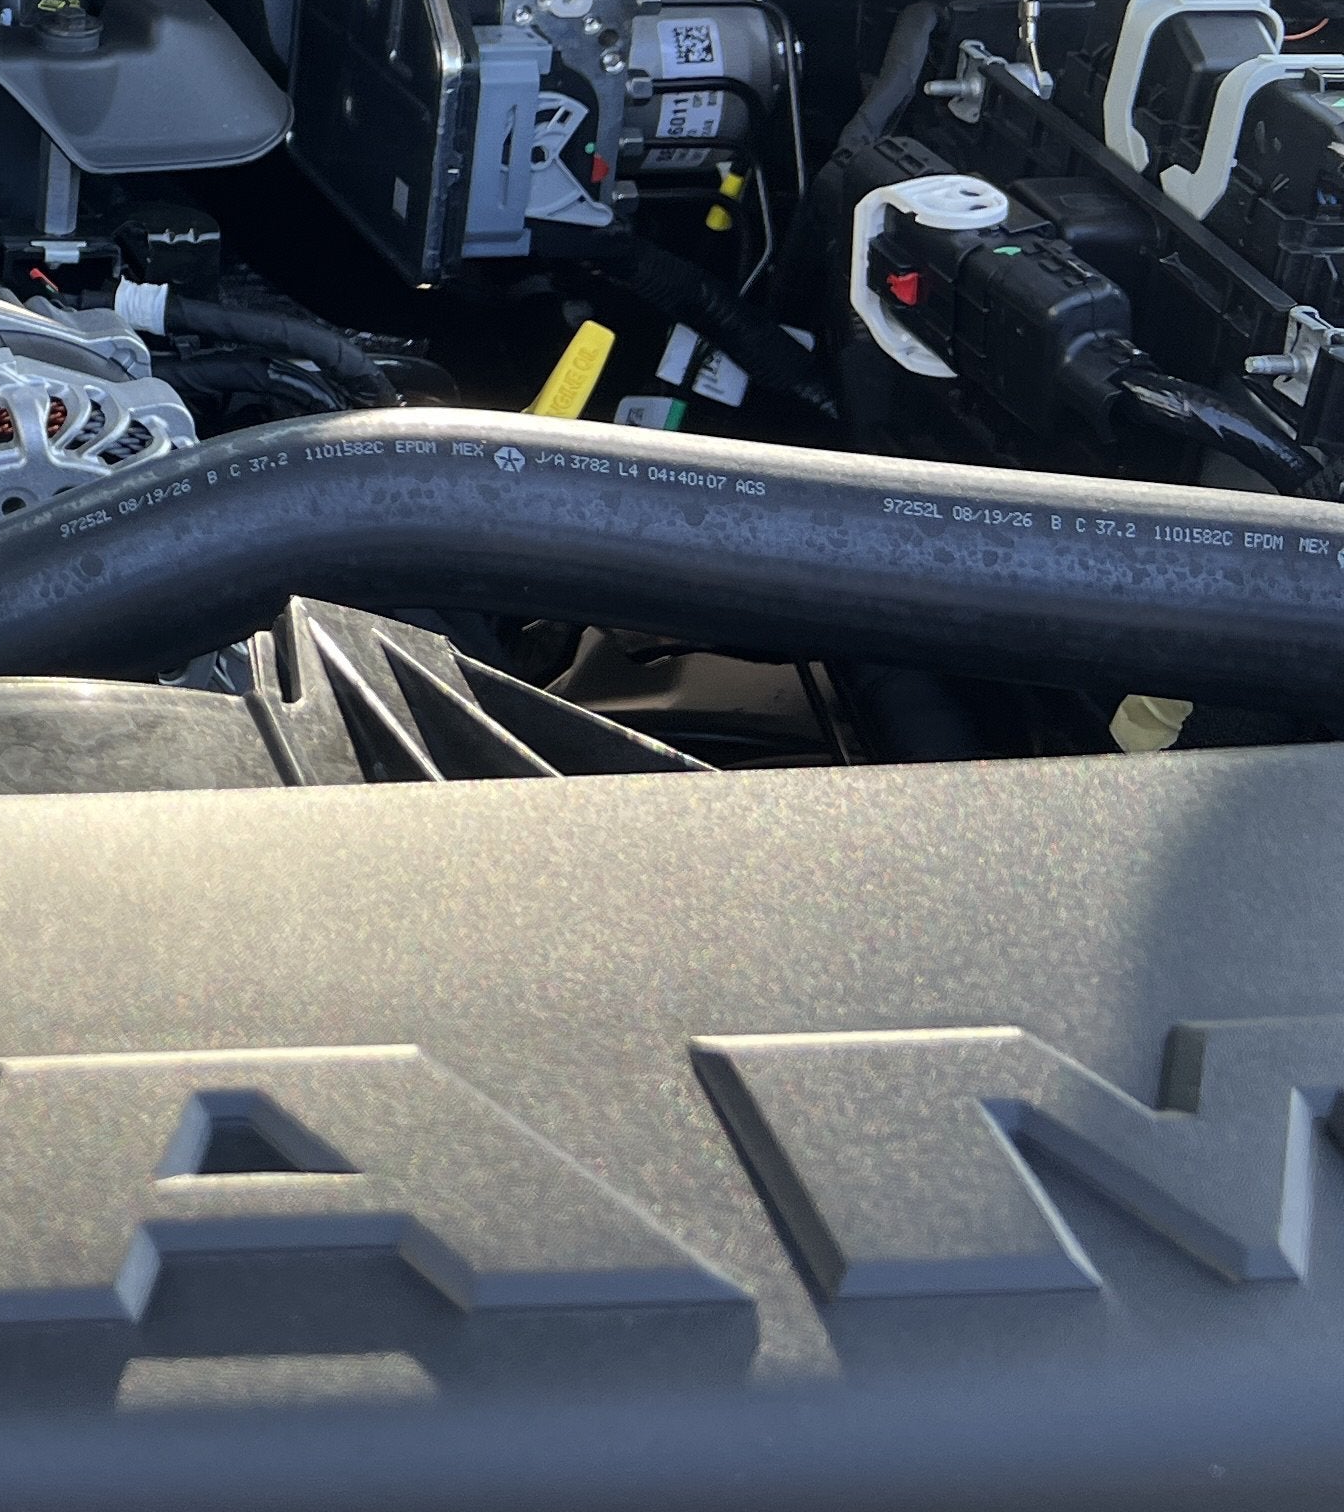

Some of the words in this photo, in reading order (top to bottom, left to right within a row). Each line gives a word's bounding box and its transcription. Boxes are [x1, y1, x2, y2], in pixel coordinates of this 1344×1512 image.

[118, 478, 192, 516] 08/19/26
[206, 470, 218, 485] B
[229, 463, 241, 478] C
[248, 451, 289, 474] 37.2
[452, 441, 485, 458] MEX
[570, 454, 611, 474] 3782
[618, 462, 639, 479] L4
[735, 477, 767, 497] AGS
[882, 497, 944, 520] 97252L
[952, 505, 1034, 528] 08/19/26
[1050, 514, 1062, 531] B
[1075, 517, 1087, 534] C
[1094, 518, 1137, 538] 37.2
[1154, 524, 1234, 547] 1101582C
[1243, 531, 1285, 551] EPDM
[1298, 535, 1330, 555] MEX
